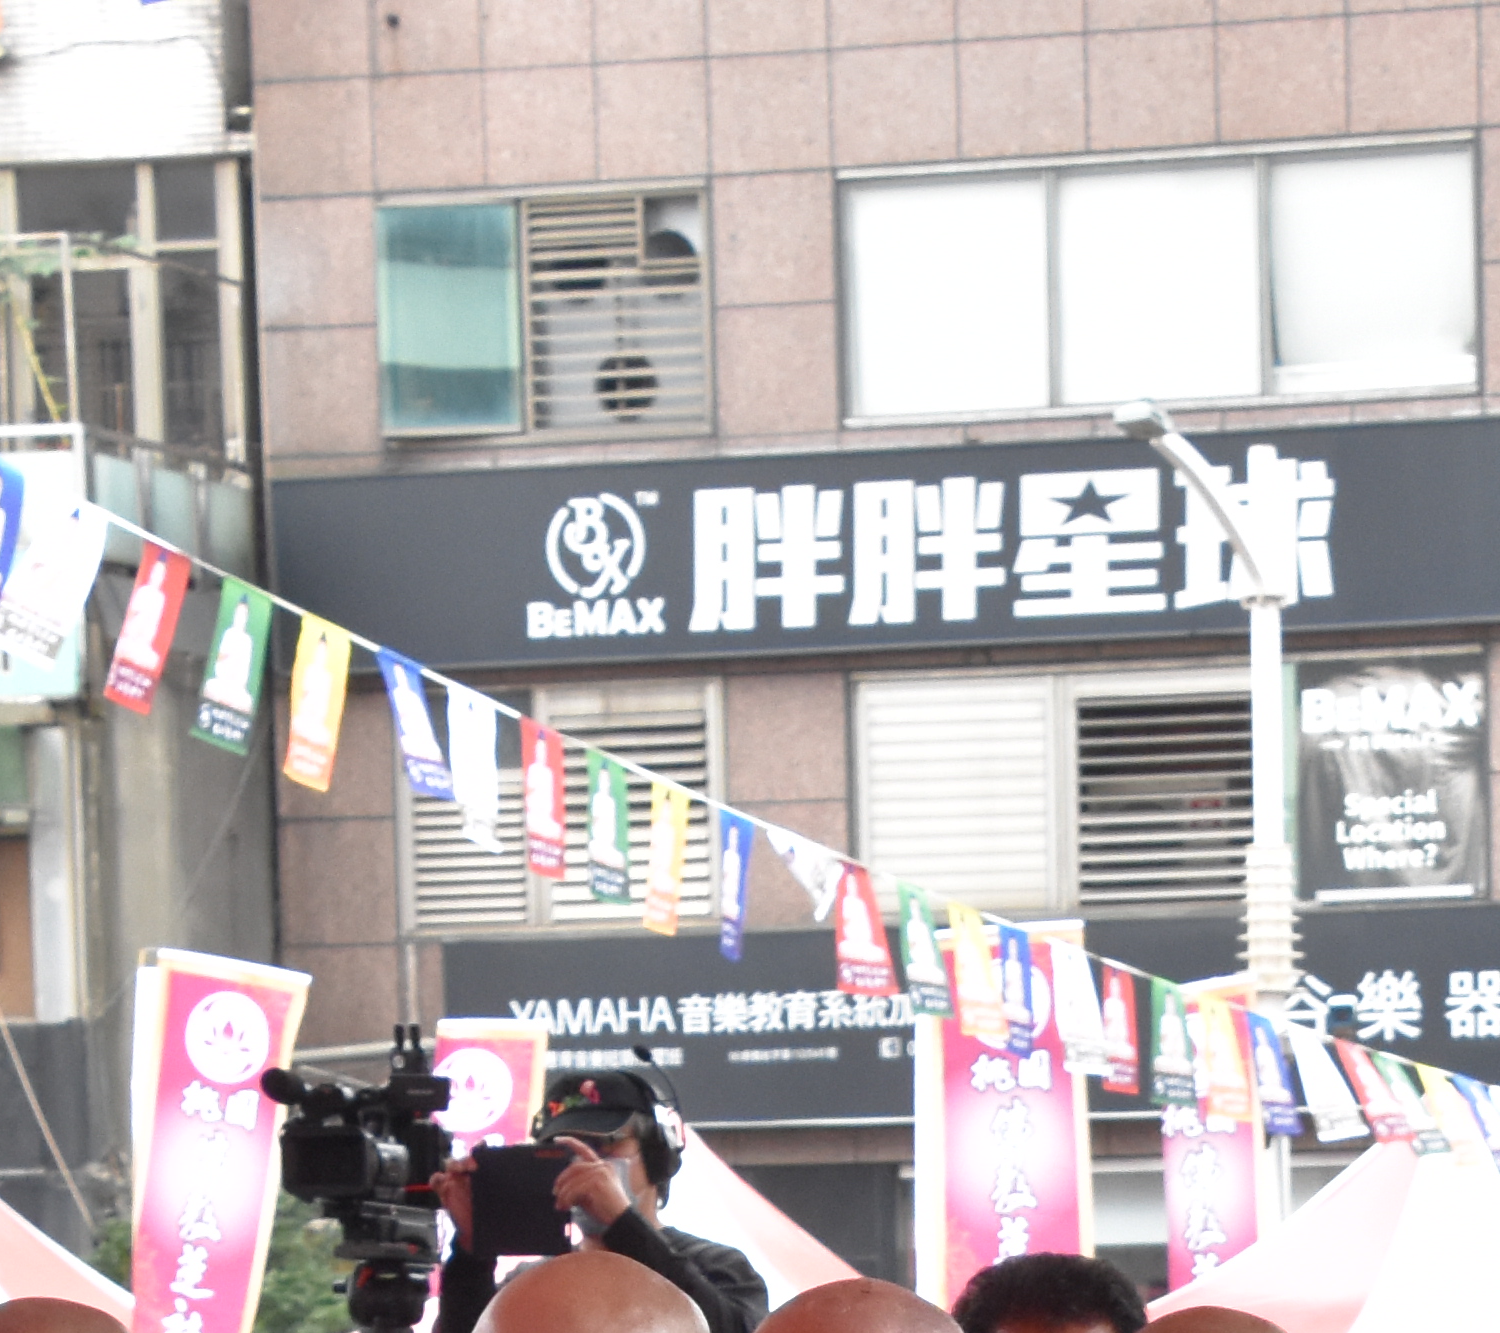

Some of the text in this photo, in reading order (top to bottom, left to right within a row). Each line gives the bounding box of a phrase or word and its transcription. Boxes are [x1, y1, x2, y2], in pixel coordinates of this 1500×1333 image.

[689, 446, 1336, 636] 胖胖星球
[1342, 789, 1439, 821] Special
[1335, 816, 1447, 845] Location
[1342, 843, 1440, 872] Where?
[510, 997, 676, 1035] YAMAHA
